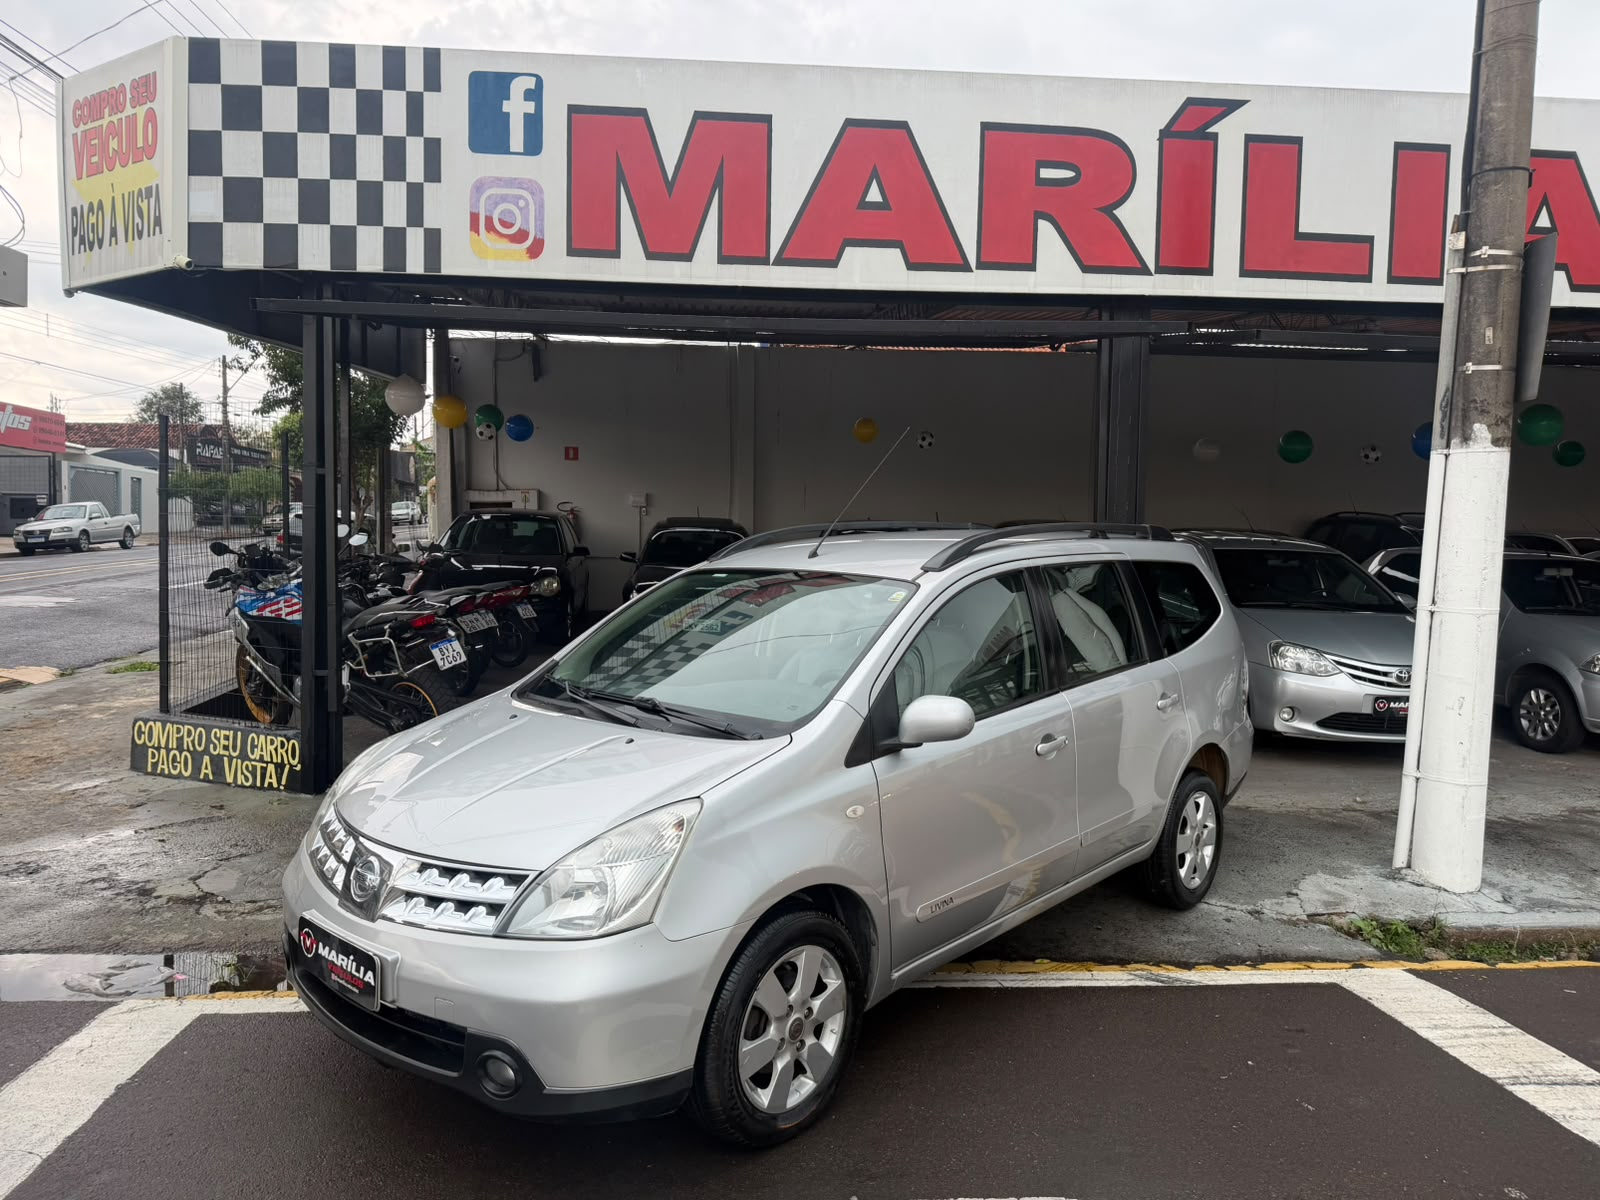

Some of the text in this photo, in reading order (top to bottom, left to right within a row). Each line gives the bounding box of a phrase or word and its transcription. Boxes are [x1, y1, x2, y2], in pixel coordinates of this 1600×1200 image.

[72, 71, 157, 128] COMPRO SEU
[72, 106, 158, 181] VEICULO
[71, 183, 163, 256] PAGO À VISTA
[440, 651, 462, 668] 7C69
[134, 721, 206, 752] COMPRO
[210, 728, 242, 757] SEU
[147, 748, 290, 790] PAGO A VISTA!
[930, 897, 953, 914] LIVINA
[318, 942, 375, 986] MARÍLIA
